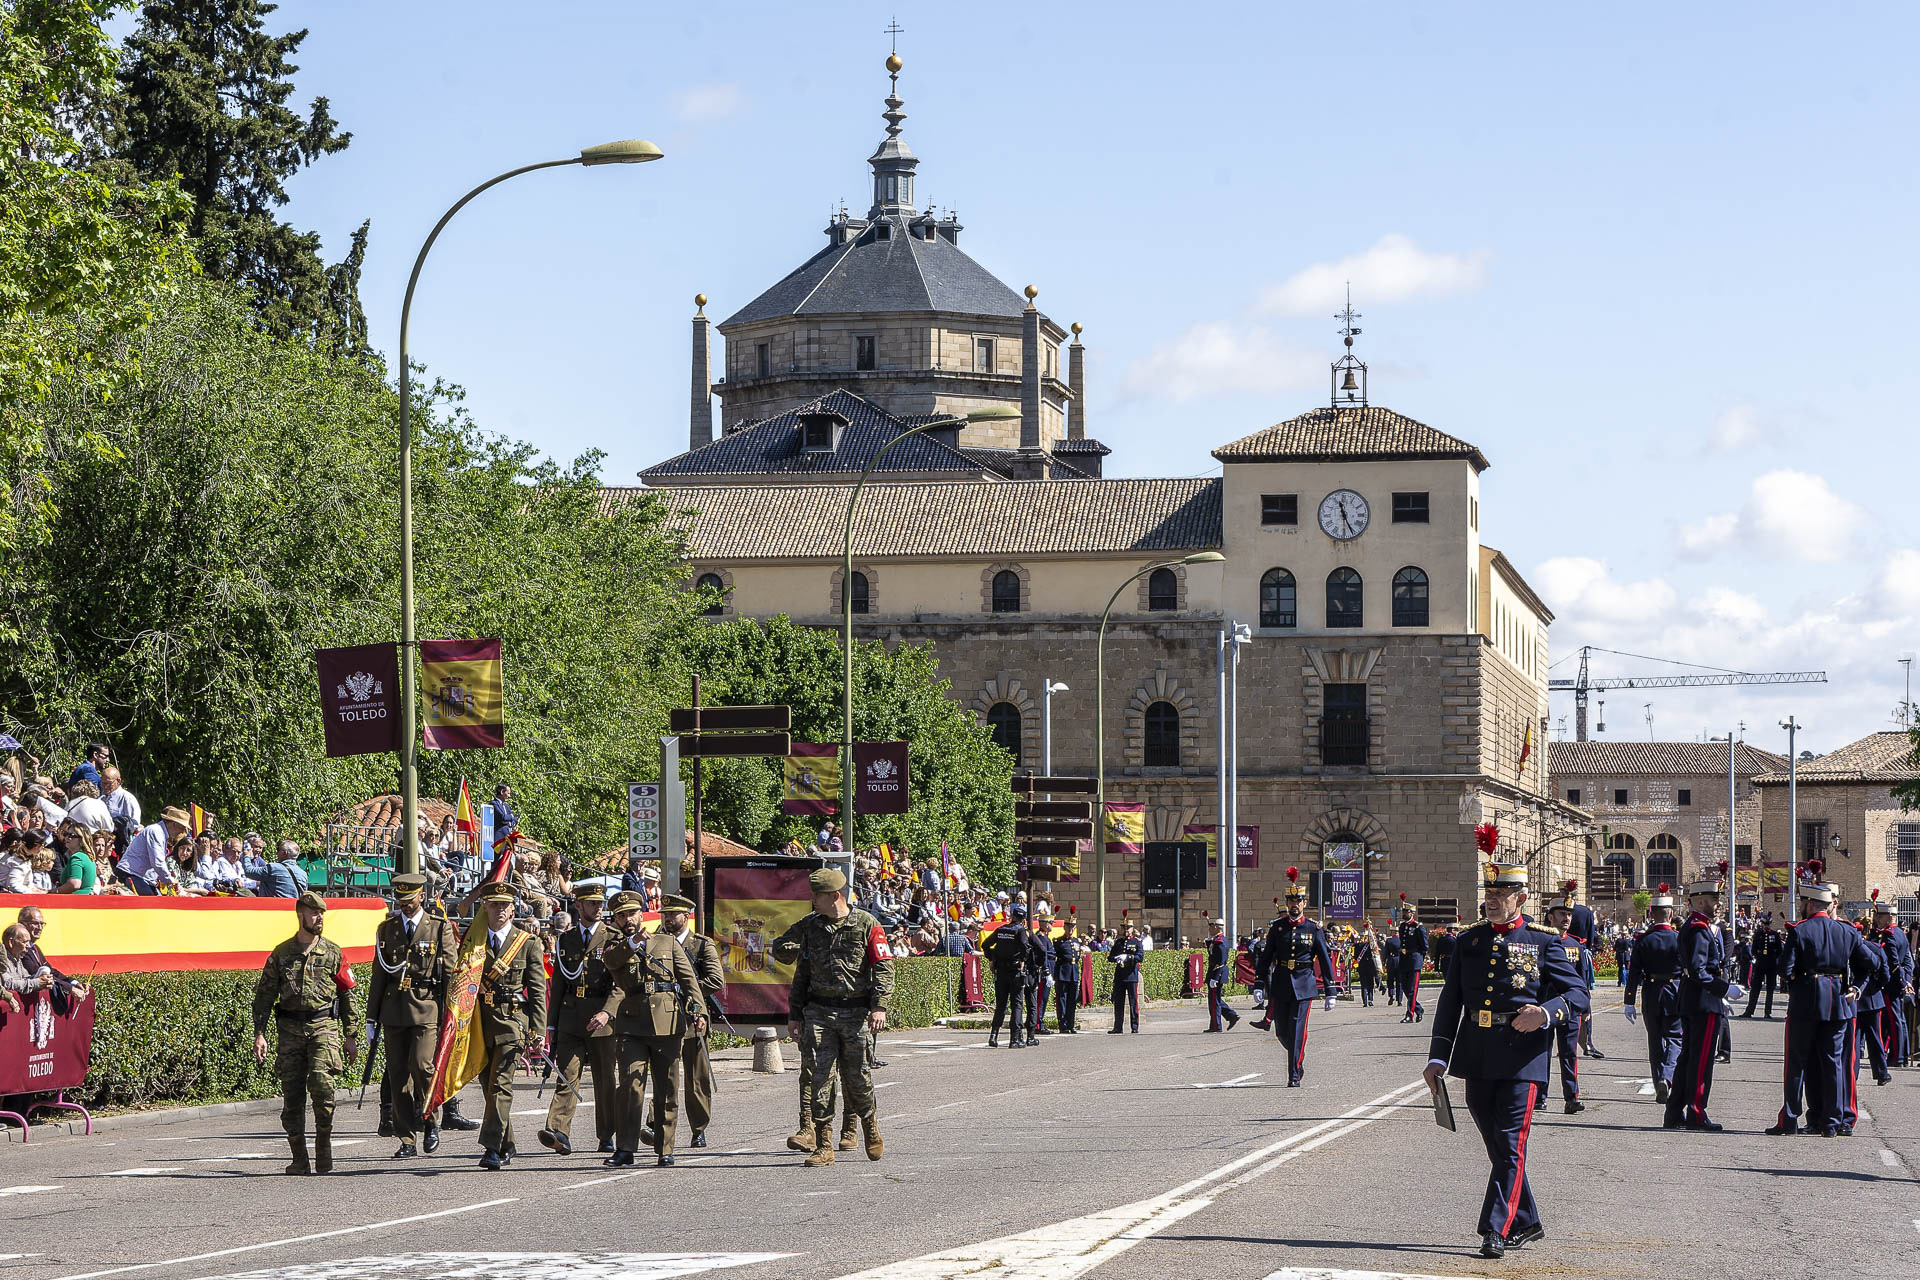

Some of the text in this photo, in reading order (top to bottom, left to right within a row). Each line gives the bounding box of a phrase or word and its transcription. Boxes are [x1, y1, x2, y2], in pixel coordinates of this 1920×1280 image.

[339, 708, 387, 722] TOLEDO
[640, 786, 648, 796] 5
[636, 799, 652, 807] 10
[637, 810, 652, 818] 41
[638, 822, 652, 830] 81
[638, 832, 654, 840] 82
[636, 846, 653, 854] B2
[1332, 892, 1357, 908] Regis
[28, 1061, 54, 1078] TOLEDO
